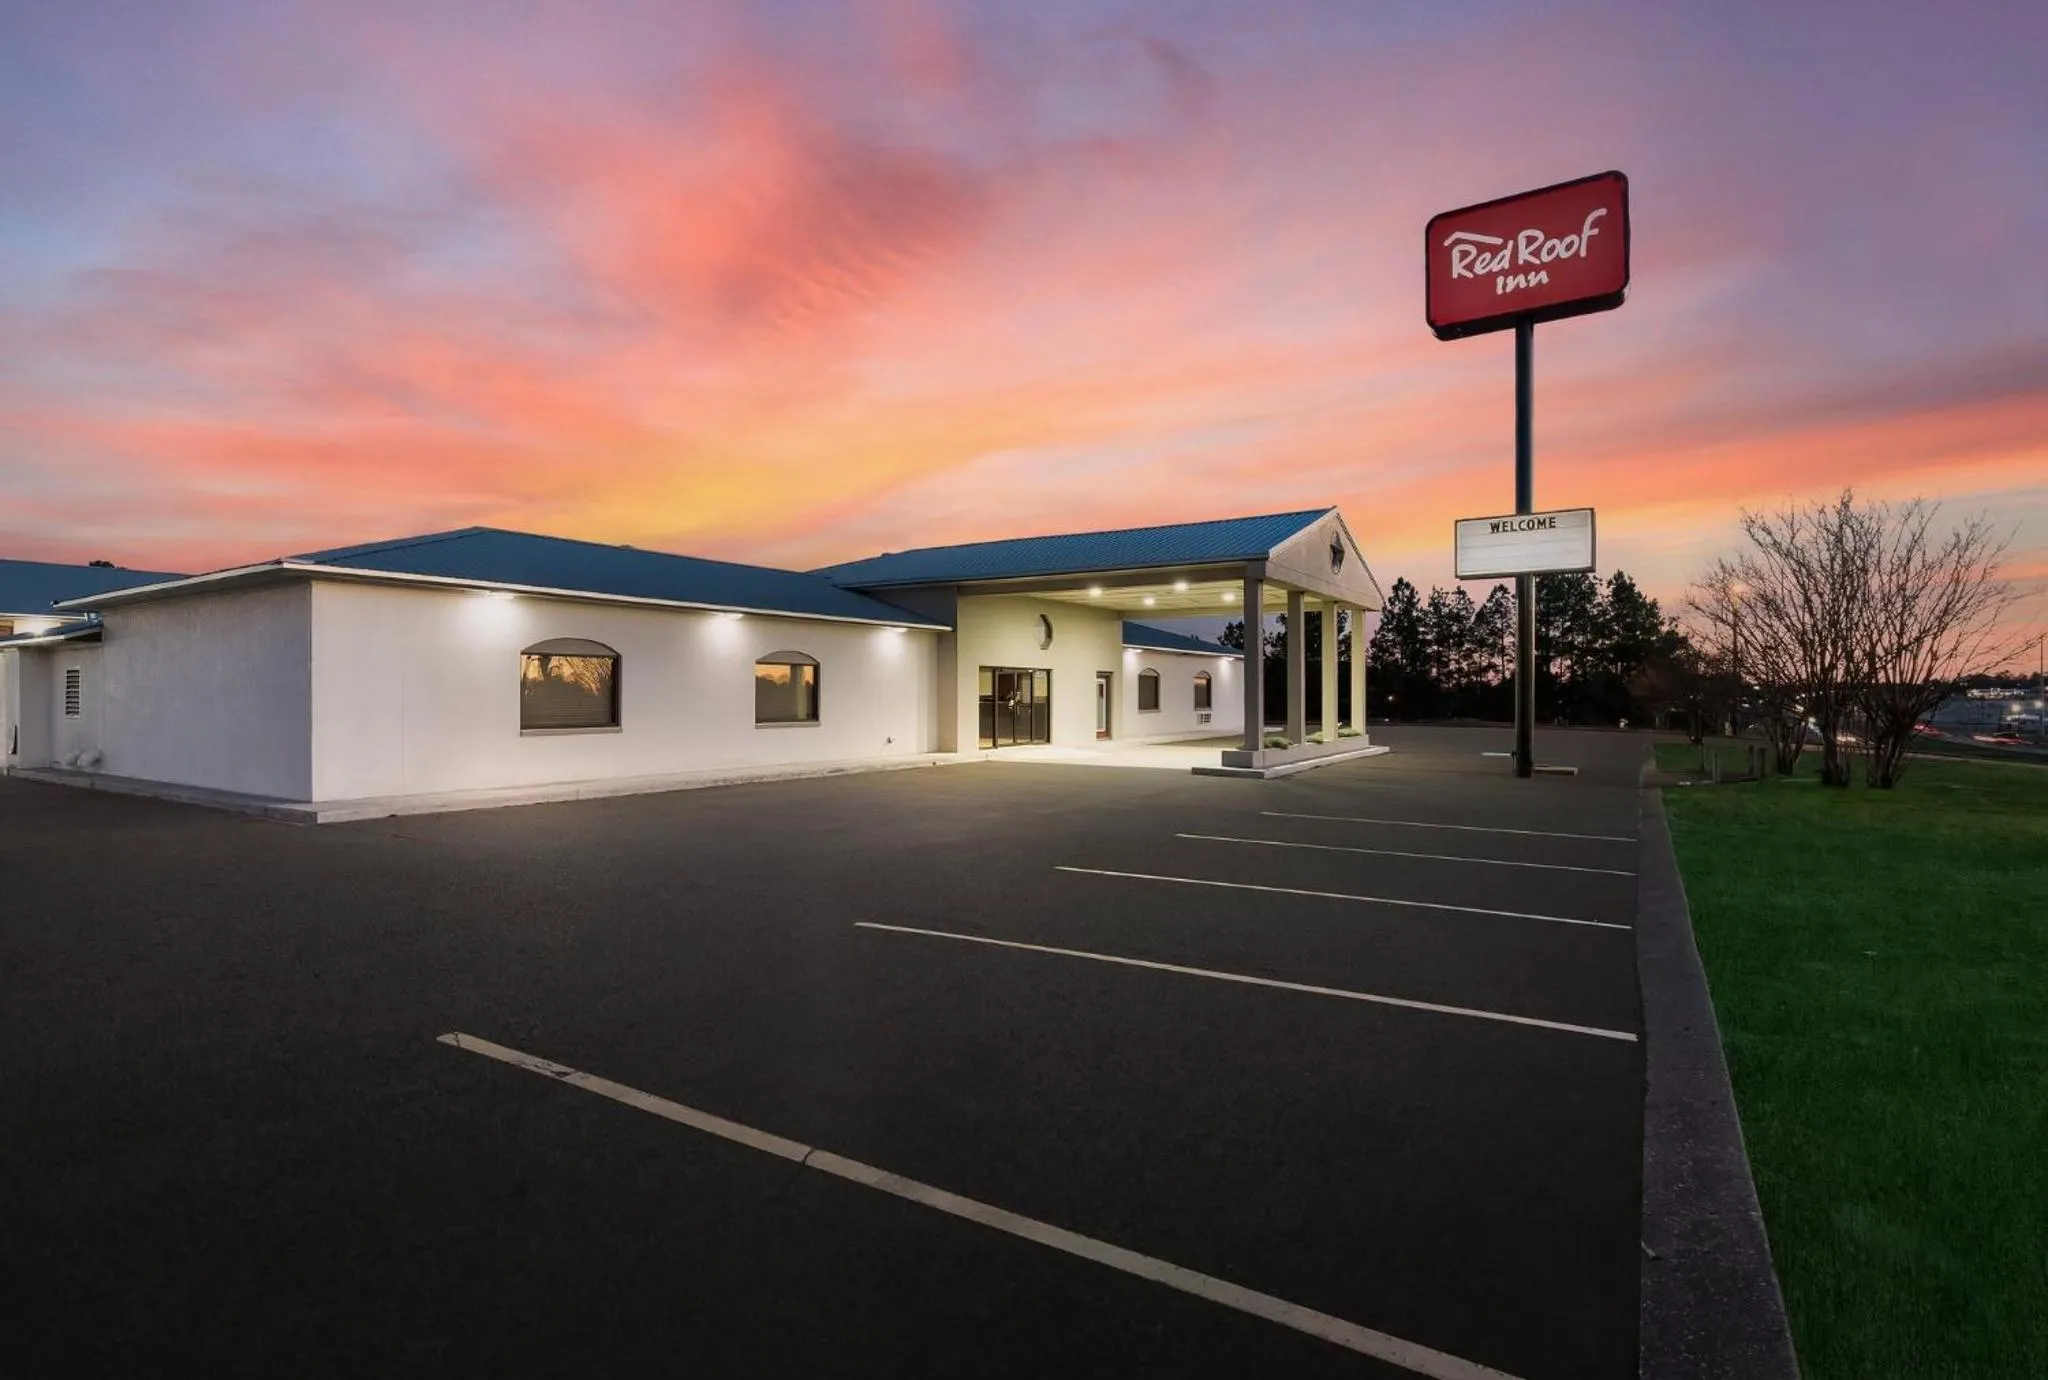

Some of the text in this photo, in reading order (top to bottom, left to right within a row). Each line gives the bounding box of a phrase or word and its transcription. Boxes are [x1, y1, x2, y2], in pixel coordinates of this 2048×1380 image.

[1452, 208, 1608, 279] Red Roof
[1490, 517, 1557, 534] WELCOME
